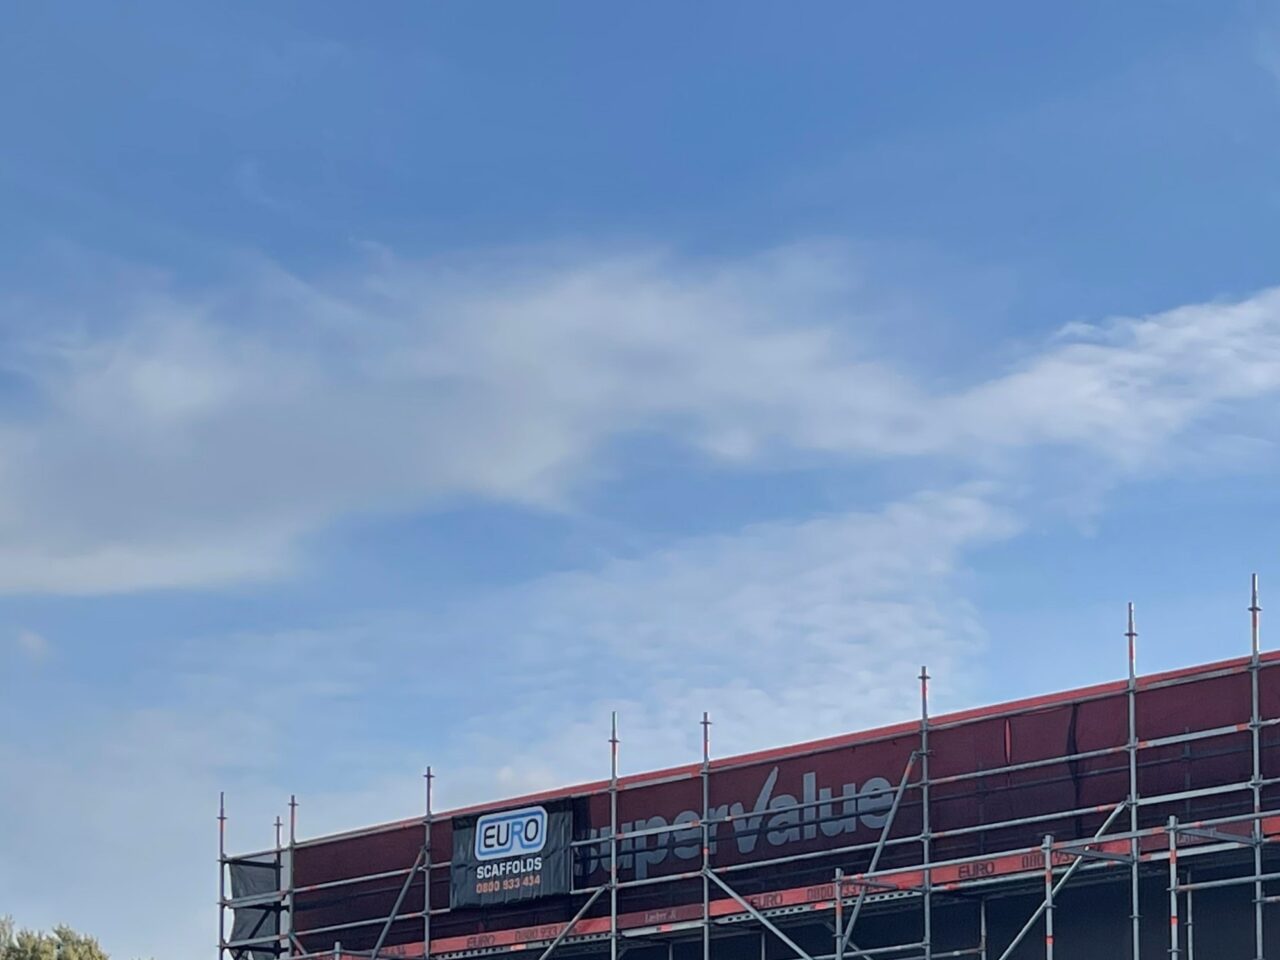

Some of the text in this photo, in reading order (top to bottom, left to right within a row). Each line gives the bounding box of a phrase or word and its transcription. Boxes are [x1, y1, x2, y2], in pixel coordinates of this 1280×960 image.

[484, 817, 540, 850] EURO
[476, 856, 542, 880] SCAFFOLDS
[958, 861, 995, 879] EURO
[751, 892, 784, 909] EURO
